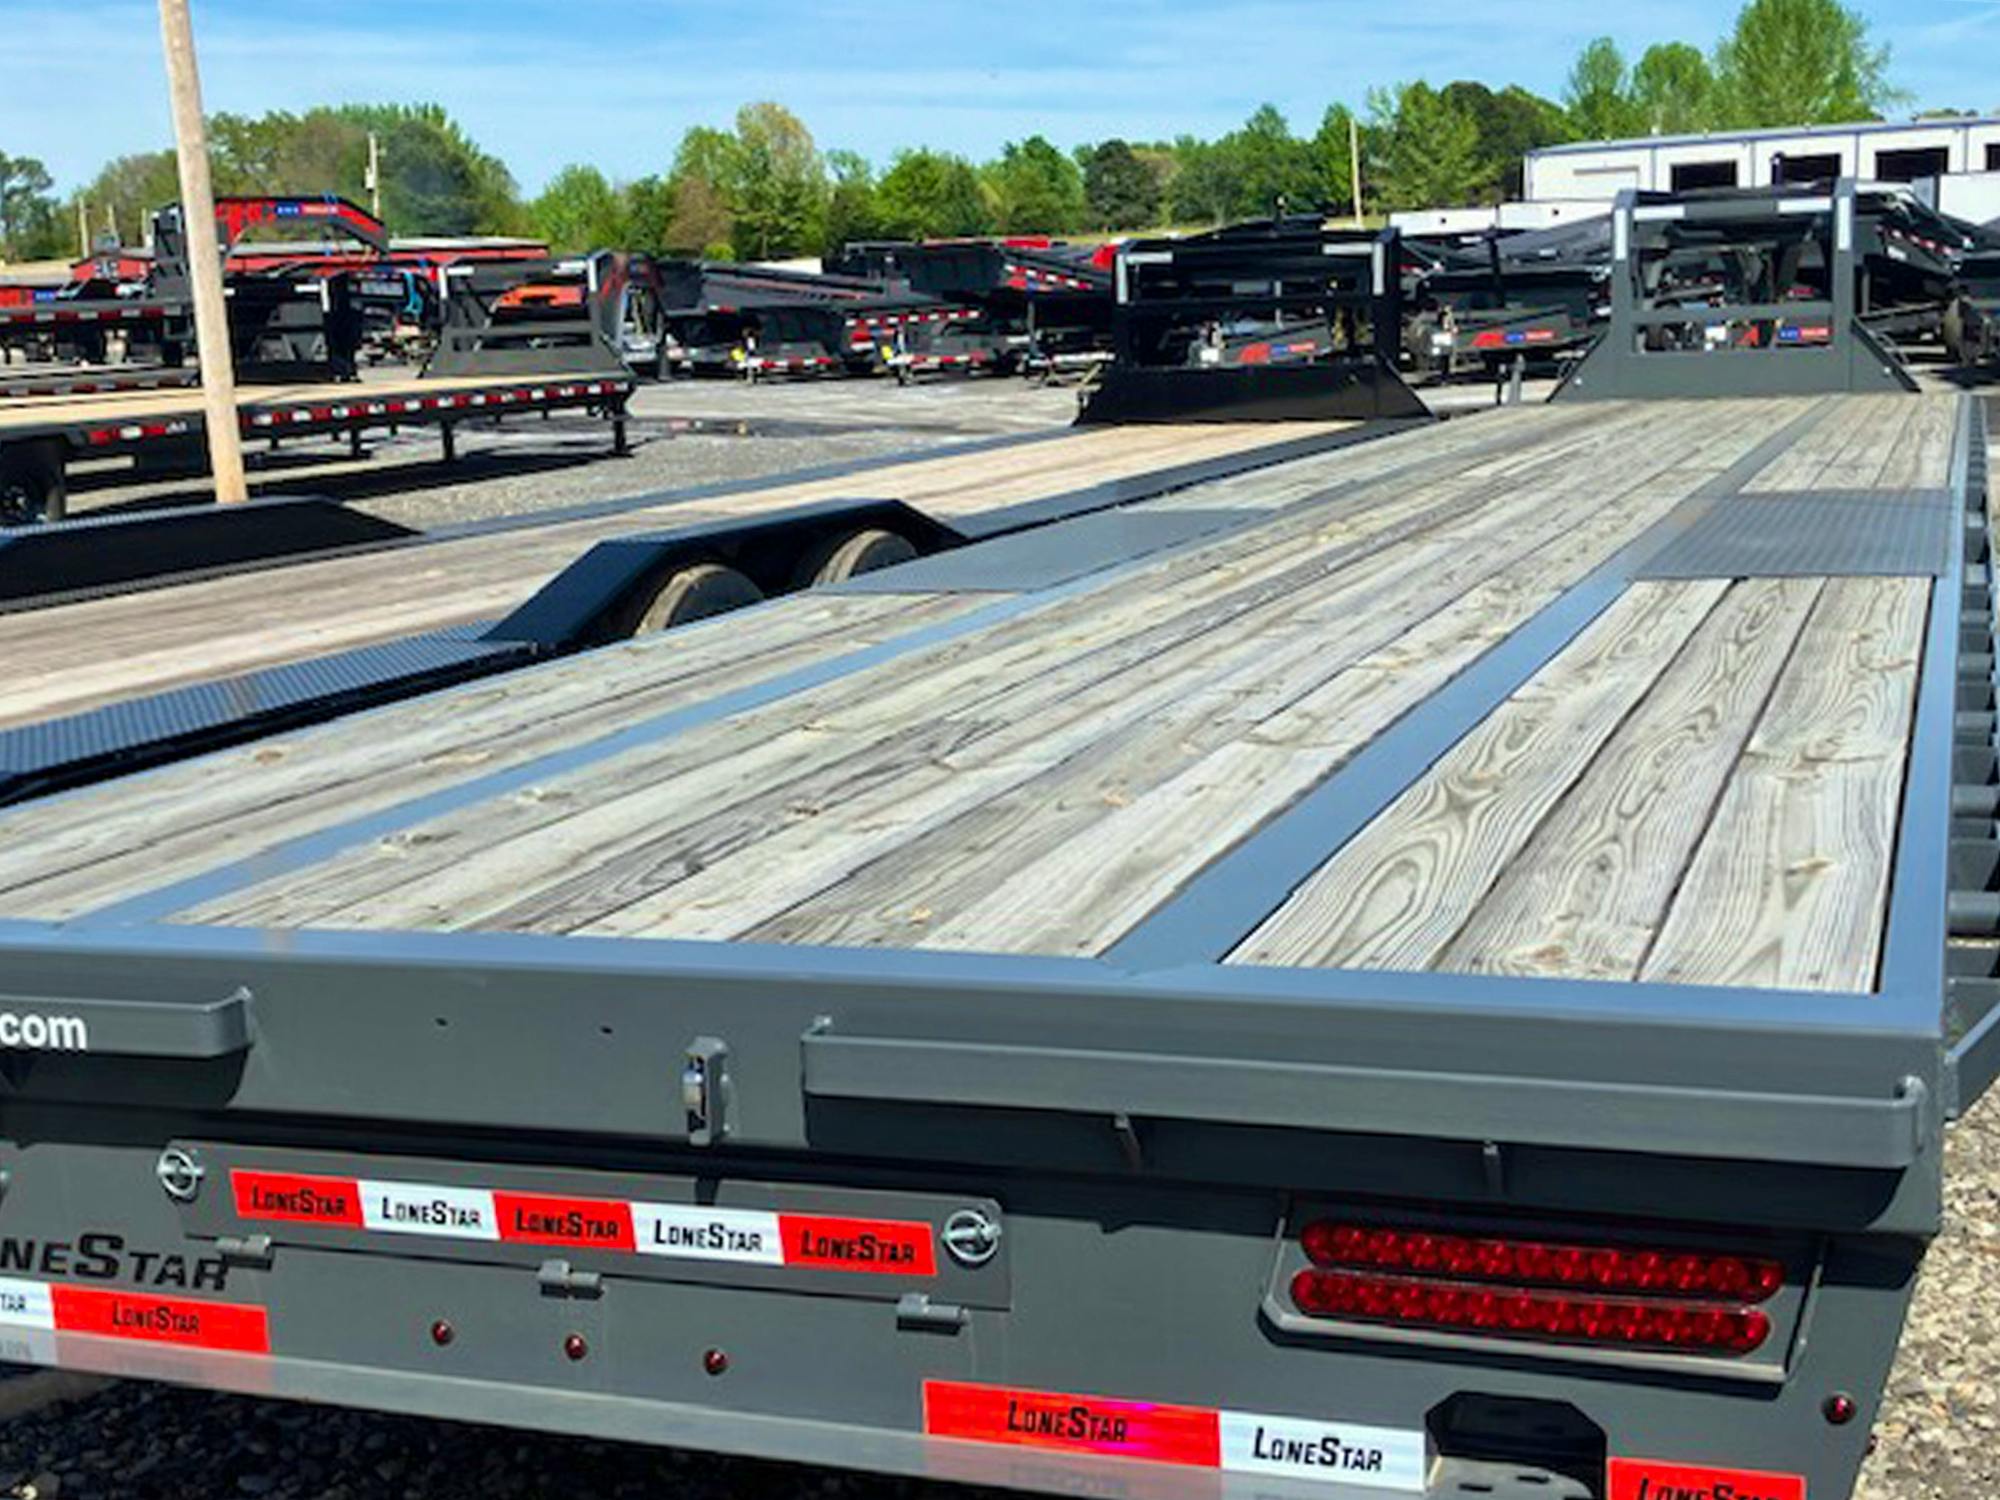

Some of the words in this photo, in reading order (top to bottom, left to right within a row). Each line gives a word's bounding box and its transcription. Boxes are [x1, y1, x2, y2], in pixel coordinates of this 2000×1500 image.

[381, 1196, 481, 1227] LONESTAR
[514, 1207, 619, 1239] LONESTAR
[654, 1219, 763, 1252] LONESTAR
[801, 1229, 915, 1264] LONESTAR
[1007, 1399, 1128, 1443] LONESTAR
[1252, 1426, 1383, 1472] LONESTAR
